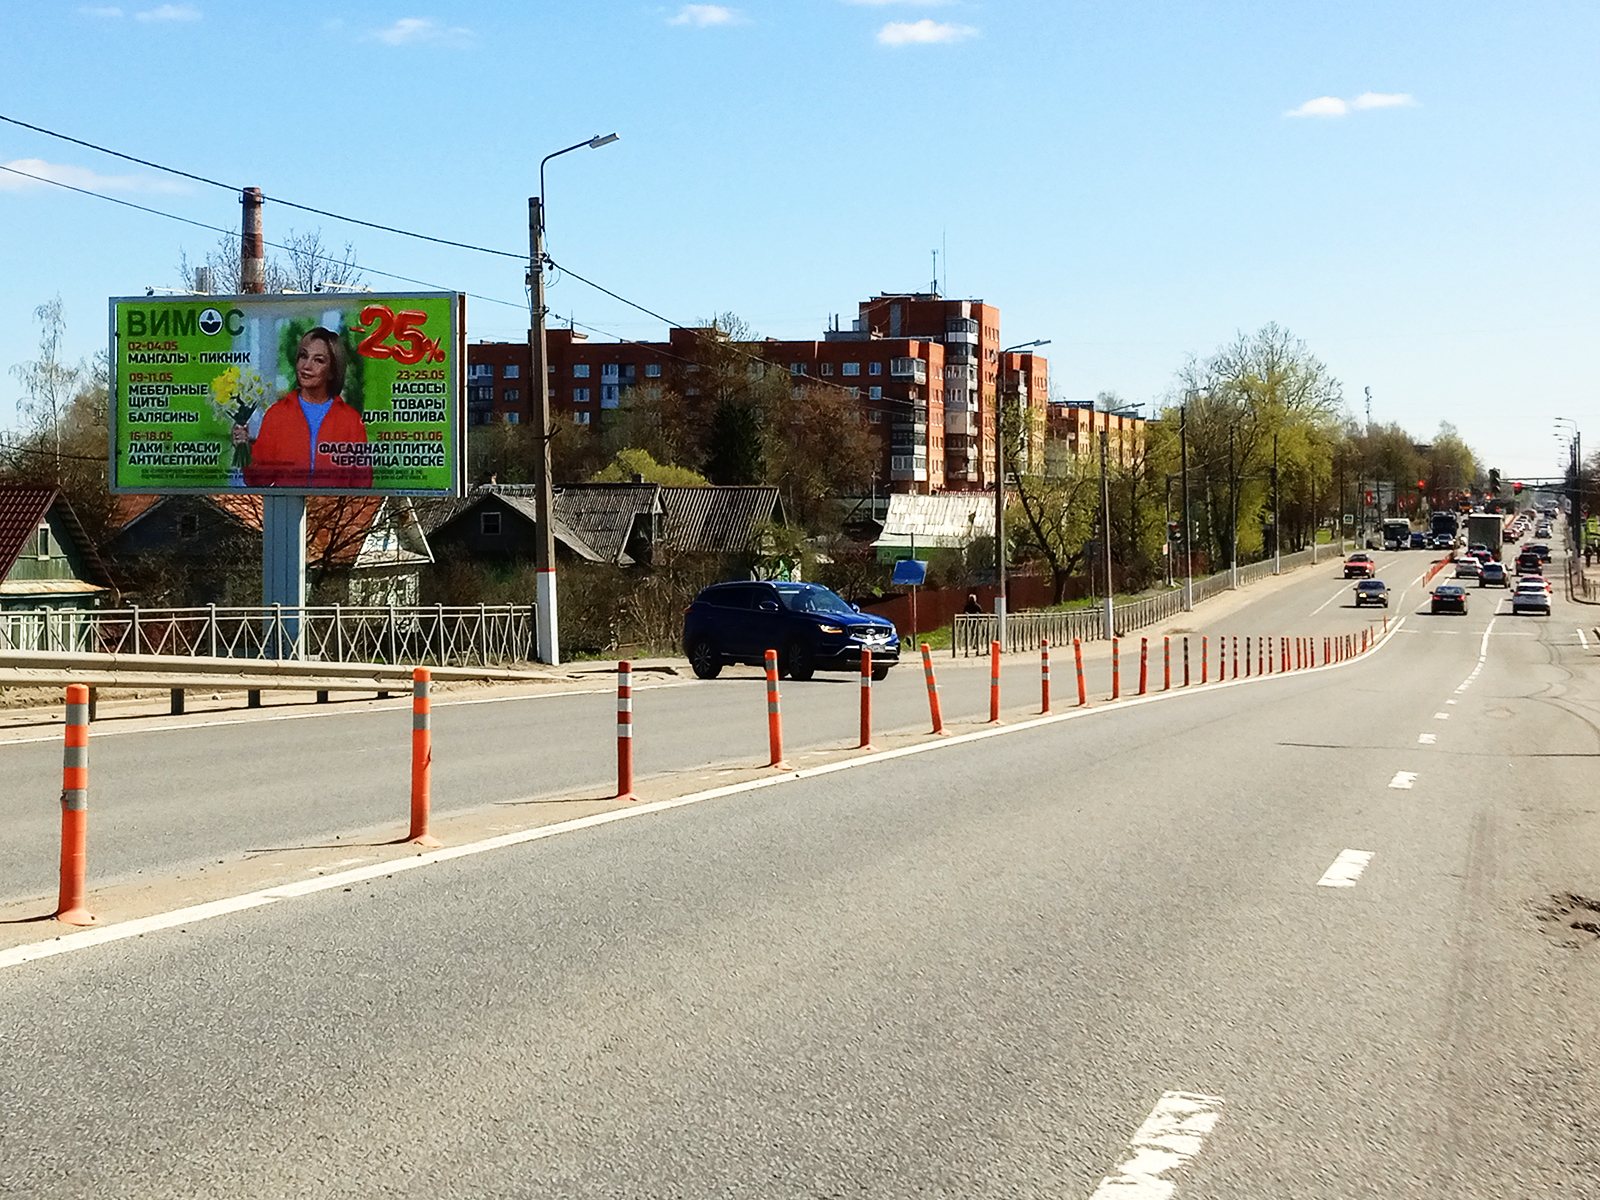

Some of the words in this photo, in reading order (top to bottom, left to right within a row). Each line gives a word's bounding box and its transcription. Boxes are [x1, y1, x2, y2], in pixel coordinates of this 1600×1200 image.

[128, 342, 178, 350] 02-04.05
[128, 353, 189, 363] МАНГАЛЫ
[200, 352, 250, 363] ПИКНИК
[129, 373, 173, 382] 09-11.05
[396, 370, 445, 379] 23-25.05
[129, 385, 208, 395] МЕБЕЛЬНЫЕ
[392, 383, 445, 393] НАСОСЫ
[129, 397, 169, 408] ЩИТЫ
[391, 399, 445, 409] ТОВАРЫ
[129, 412, 198, 422] БАЛЯСИНЫ
[362, 411, 389, 423] ДЛЯ
[393, 411, 445, 421] ПОЛИВА
[130, 432, 173, 441] 16-18.05
[377, 431, 443, 441] 30.05-01.06
[129, 443, 162, 453] ЛАКИ
[173, 443, 221, 453] КРАСКИ
[319, 443, 389, 455] ФАСАДНАЯ
[393, 443, 444, 453] ПЛИТКА
[129, 455, 218, 465] АНТИСЕПТИКИ
[331, 455, 399, 467] ЧЕРЕПИЦА
